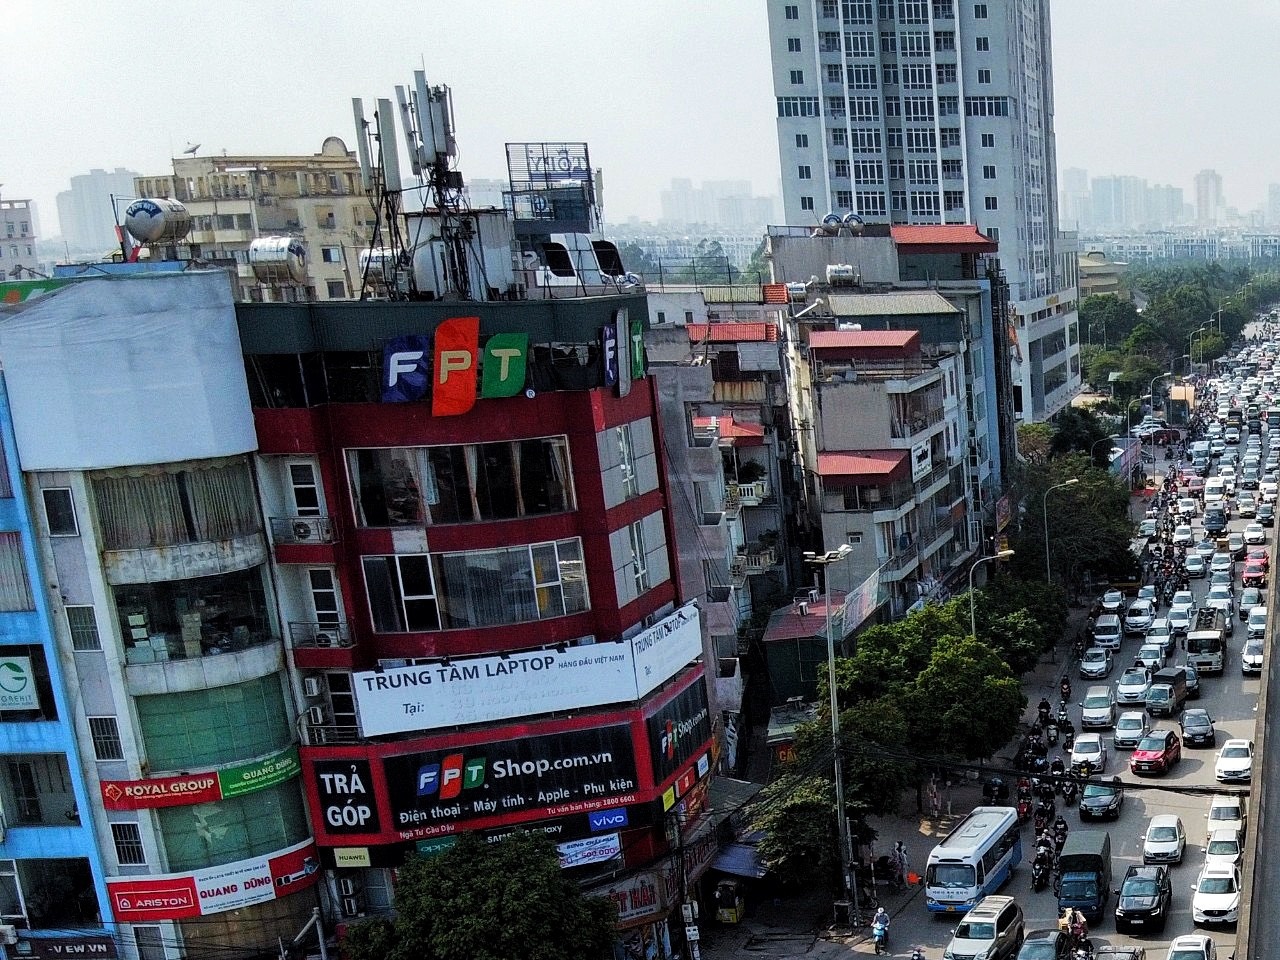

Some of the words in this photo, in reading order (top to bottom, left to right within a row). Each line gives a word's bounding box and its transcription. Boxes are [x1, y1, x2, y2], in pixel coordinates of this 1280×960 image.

[388, 349, 522, 387] FPT
[363, 668, 432, 692] TRUNG
[436, 664, 481, 684] TÂM
[485, 656, 555, 677] LAPTOP
[609, 653, 625, 664] NAM
[402, 702, 425, 715] Tại:
[242, 765, 275, 780] QUANG
[320, 764, 367, 795] TRẢ
[419, 764, 484, 790] FPT
[493, 752, 613, 779] Shop.com.vn
[125, 781, 168, 797] ROYAL
[170, 779, 215, 794] GROUP
[327, 798, 371, 827] GÓP
[400, 810, 427, 825] Điện
[430, 802, 461, 821] thoại
[474, 798, 497, 813] Máy
[502, 794, 525, 808] tính
[537, 787, 570, 805] Apple
[584, 781, 605, 796] Phụ
[609, 777, 634, 793] kiện
[593, 813, 625, 828] vivo
[338, 853, 366, 862] HUAWEI
[200, 884, 239, 899] QUANG
[243, 875, 272, 890] DŨNG
[135, 896, 188, 908] ARISTON
